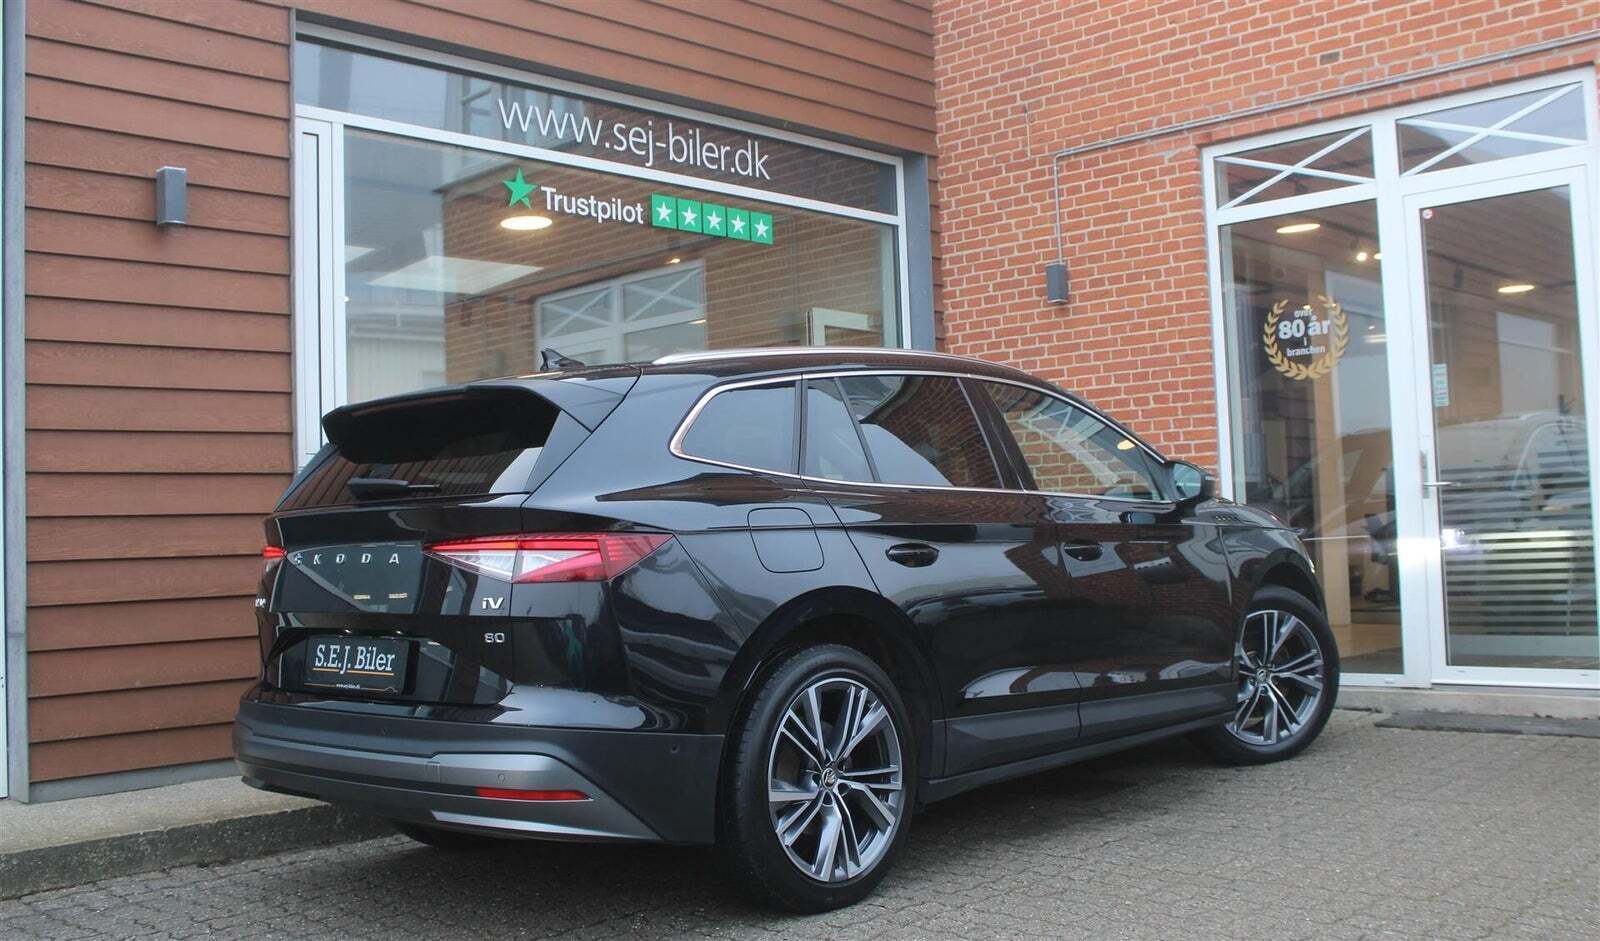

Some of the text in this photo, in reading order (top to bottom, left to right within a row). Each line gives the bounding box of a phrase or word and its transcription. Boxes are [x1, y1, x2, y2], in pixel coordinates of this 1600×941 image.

[498, 98, 770, 180] www.sej-biler.dk
[541, 186, 644, 224] Trustpilot
[1278, 315, 1330, 339] 80 år
[484, 632, 505, 643] 80
[314, 644, 396, 674] S.E.J. Biler
